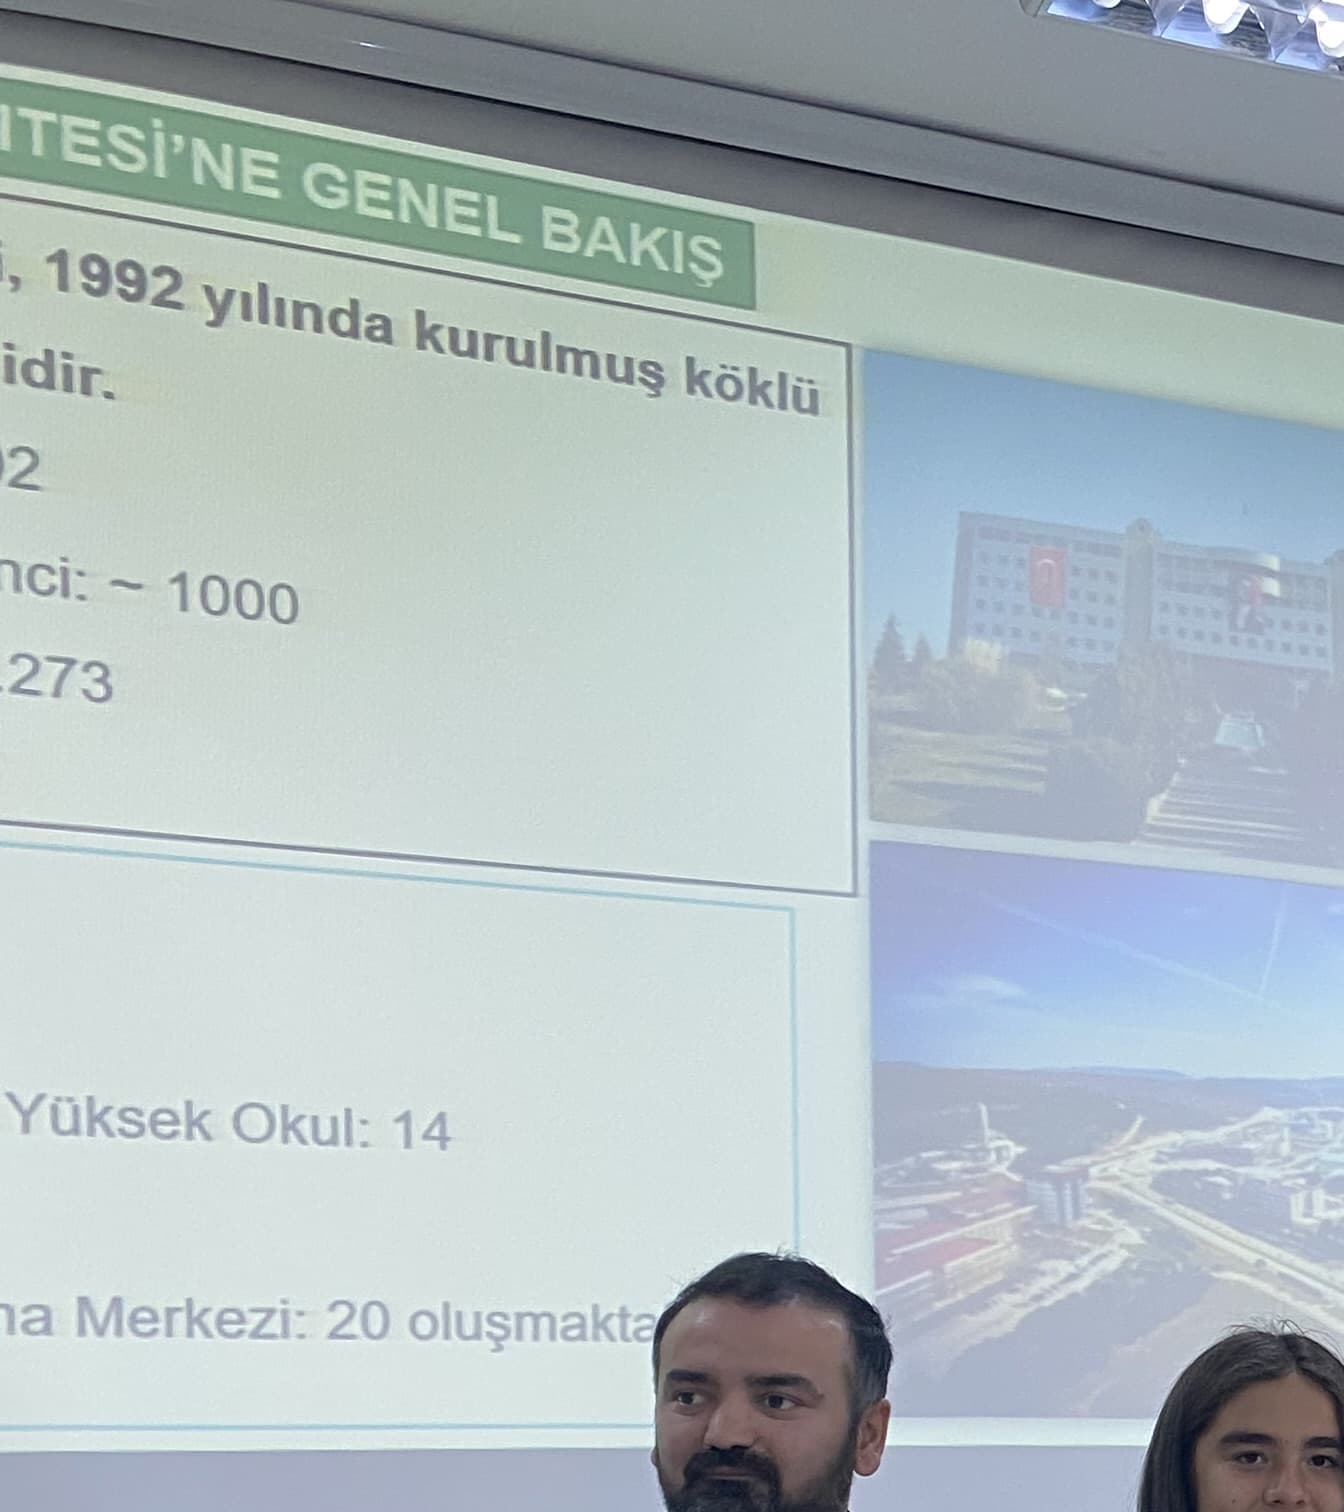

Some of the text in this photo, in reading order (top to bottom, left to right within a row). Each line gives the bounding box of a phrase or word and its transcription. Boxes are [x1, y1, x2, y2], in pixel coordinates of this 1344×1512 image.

[301, 161, 522, 245] GENEL
[541, 206, 725, 288] BAKIŞ
[46, 247, 185, 310] 1992
[202, 281, 394, 345] yılında
[414, 309, 666, 398] kurulmuş
[684, 356, 822, 416] köklü
[3, 341, 116, 400] idir.
[169, 571, 299, 625] 1000
[5, 1091, 452, 1151] Yüksek Okul: 14
[76, 1295, 306, 1340] Merkezi:
[327, 1299, 391, 1341] 20
